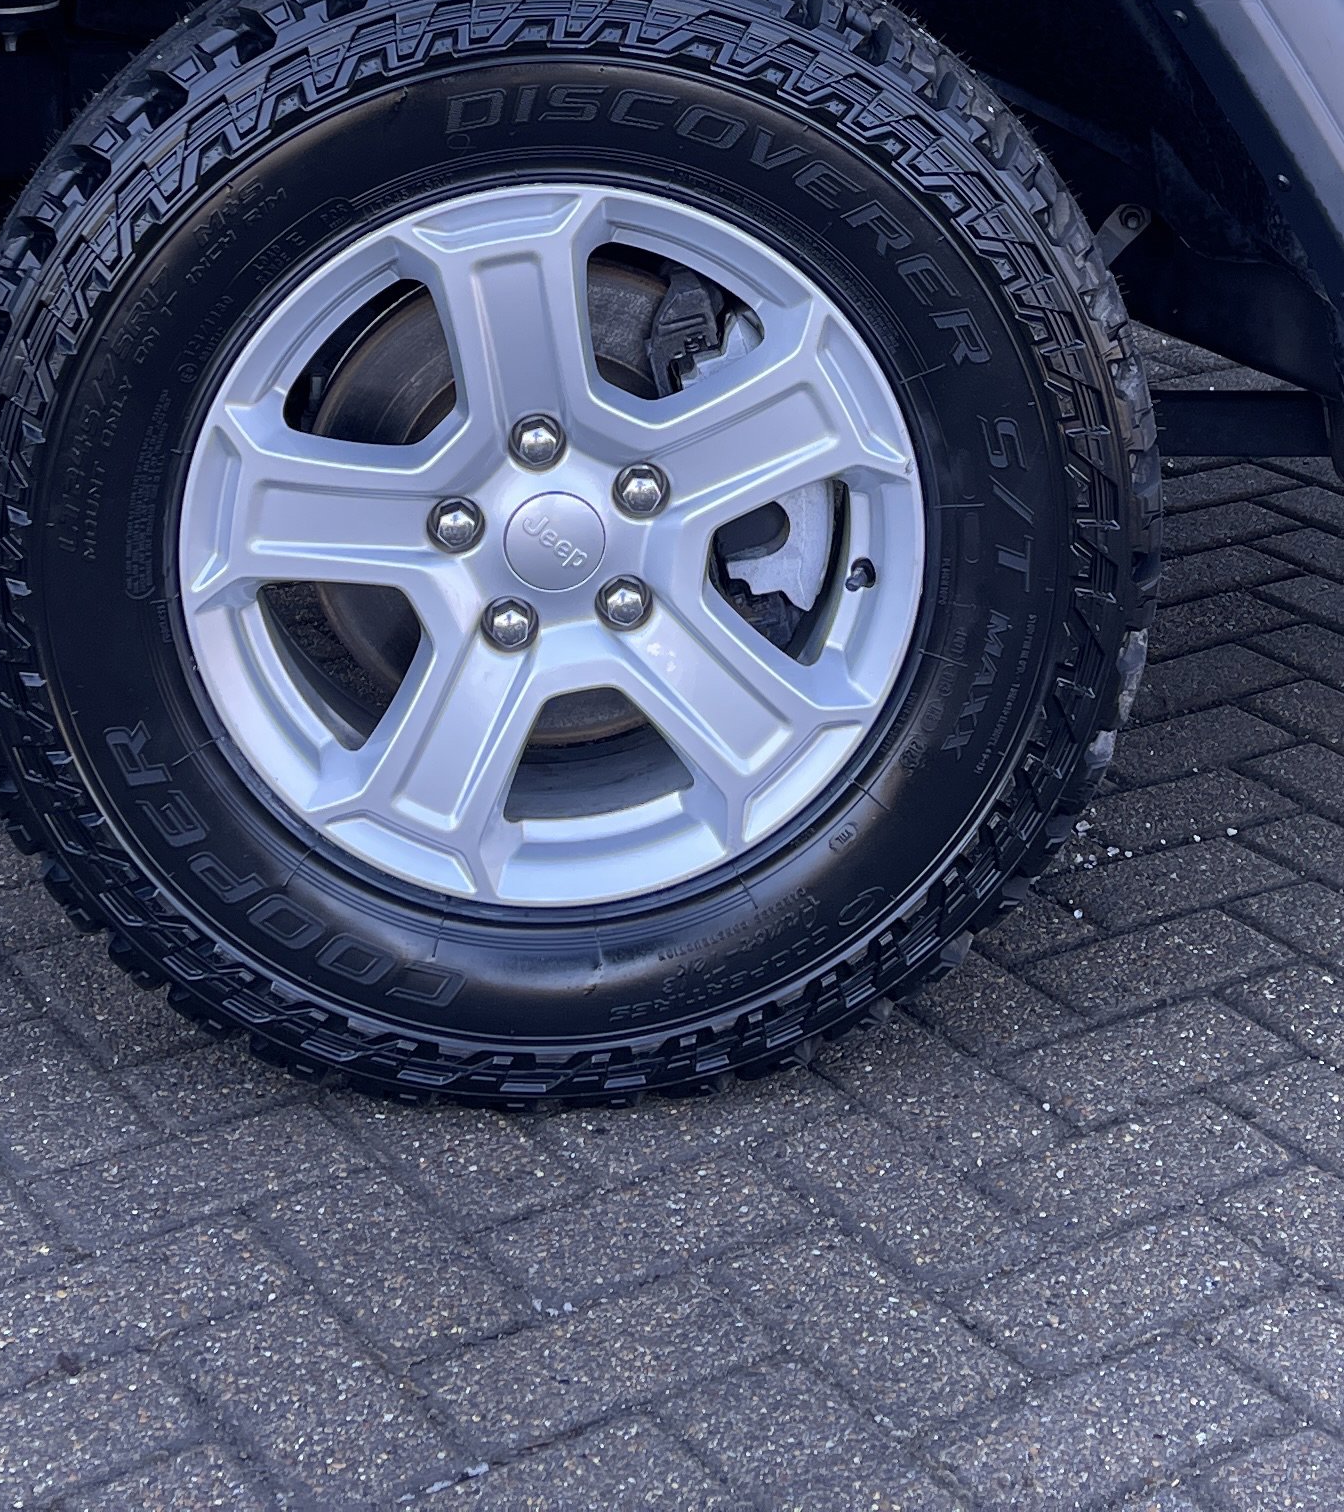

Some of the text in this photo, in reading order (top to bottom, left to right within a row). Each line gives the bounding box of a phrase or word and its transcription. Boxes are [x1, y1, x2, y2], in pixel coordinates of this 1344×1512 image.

[189, 173, 267, 247] M+S
[443, 82, 994, 372] DISCOVERER
[81, 458, 107, 560] MOUNT
[97, 372, 136, 448] ONLY
[131, 324, 162, 364] ON
[184, 227, 239, 285] INCH
[240, 184, 290, 228] RIM
[522, 516, 587, 567] Jeep
[973, 403, 1035, 592] S/T
[939, 608, 1012, 761] MAXX
[103, 718, 466, 1013] COOPER
